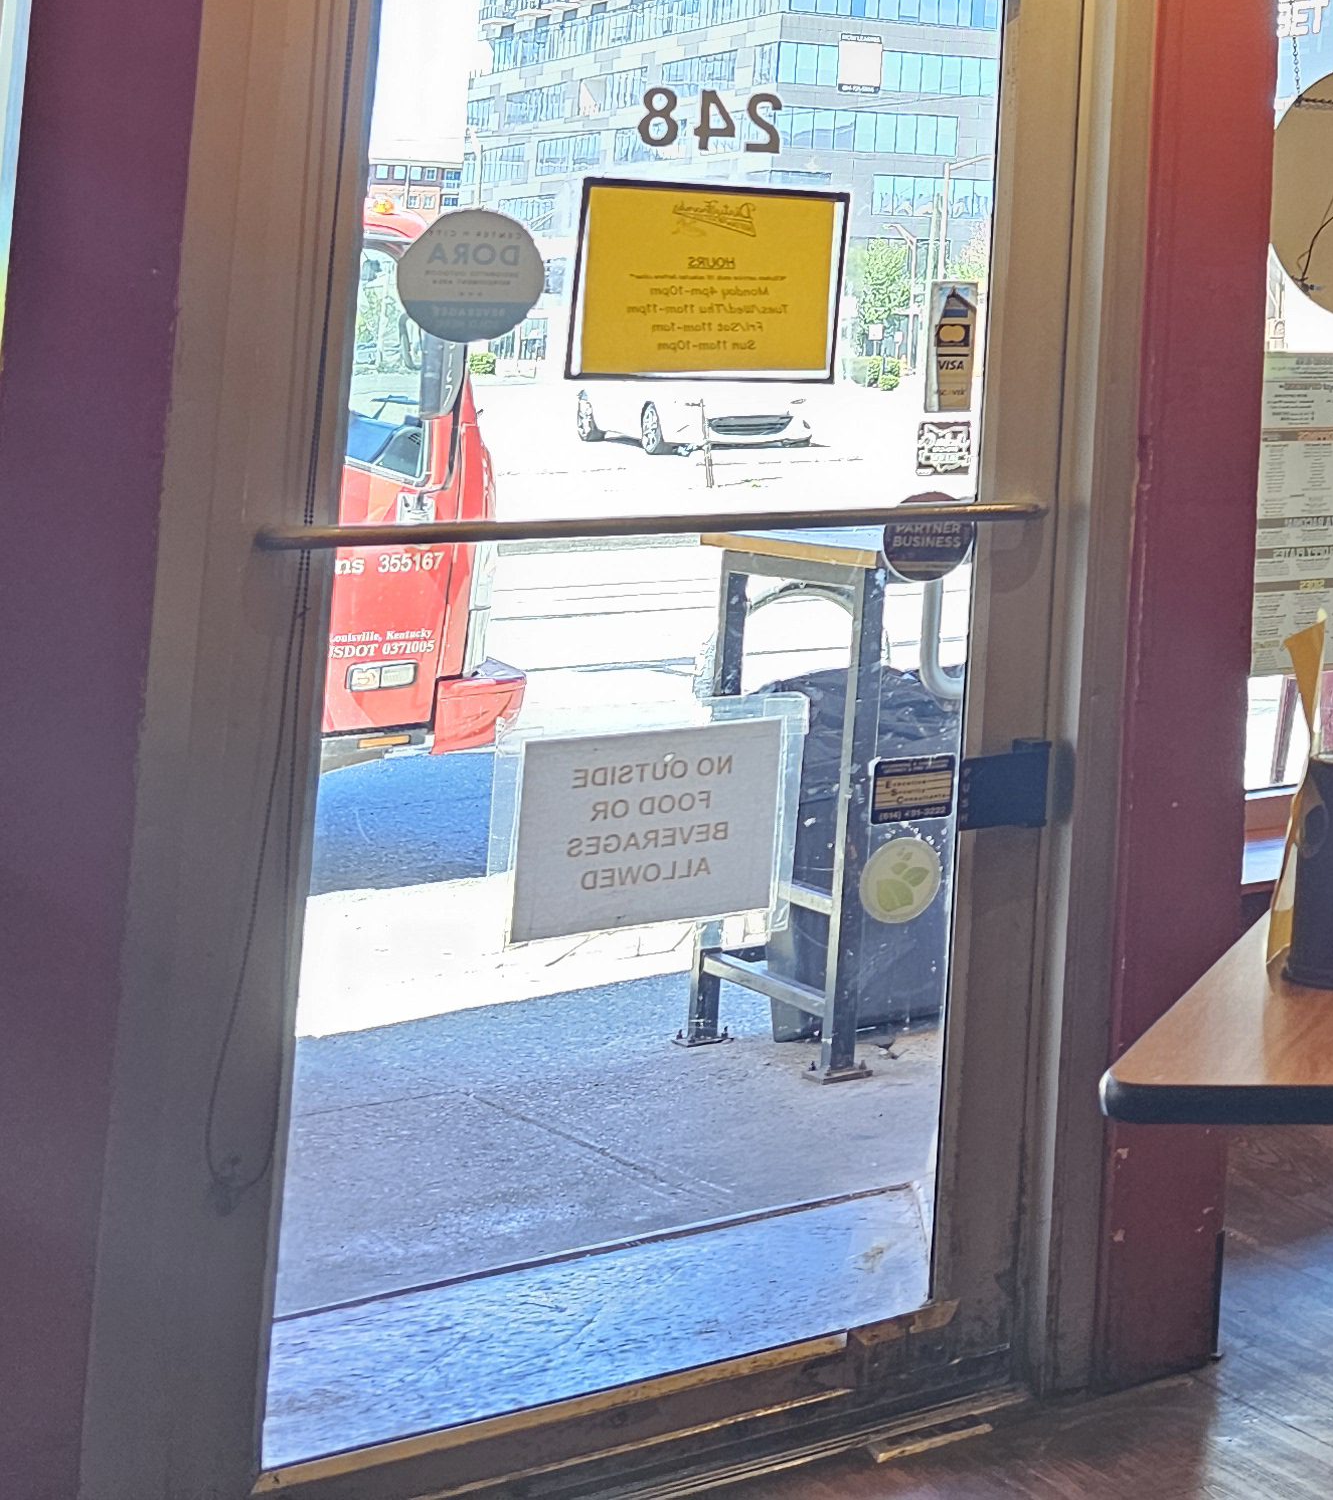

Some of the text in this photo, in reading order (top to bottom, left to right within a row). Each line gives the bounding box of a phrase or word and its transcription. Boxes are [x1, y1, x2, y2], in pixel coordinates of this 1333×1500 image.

[937, 359, 964, 372] VISA
[894, 522, 961, 536] PARTNER
[892, 535, 962, 549] BUSINESS
[378, 551, 444, 573] 355167
[386, 628, 433, 641] Kentucky
[381, 639, 436, 656] 0371005
